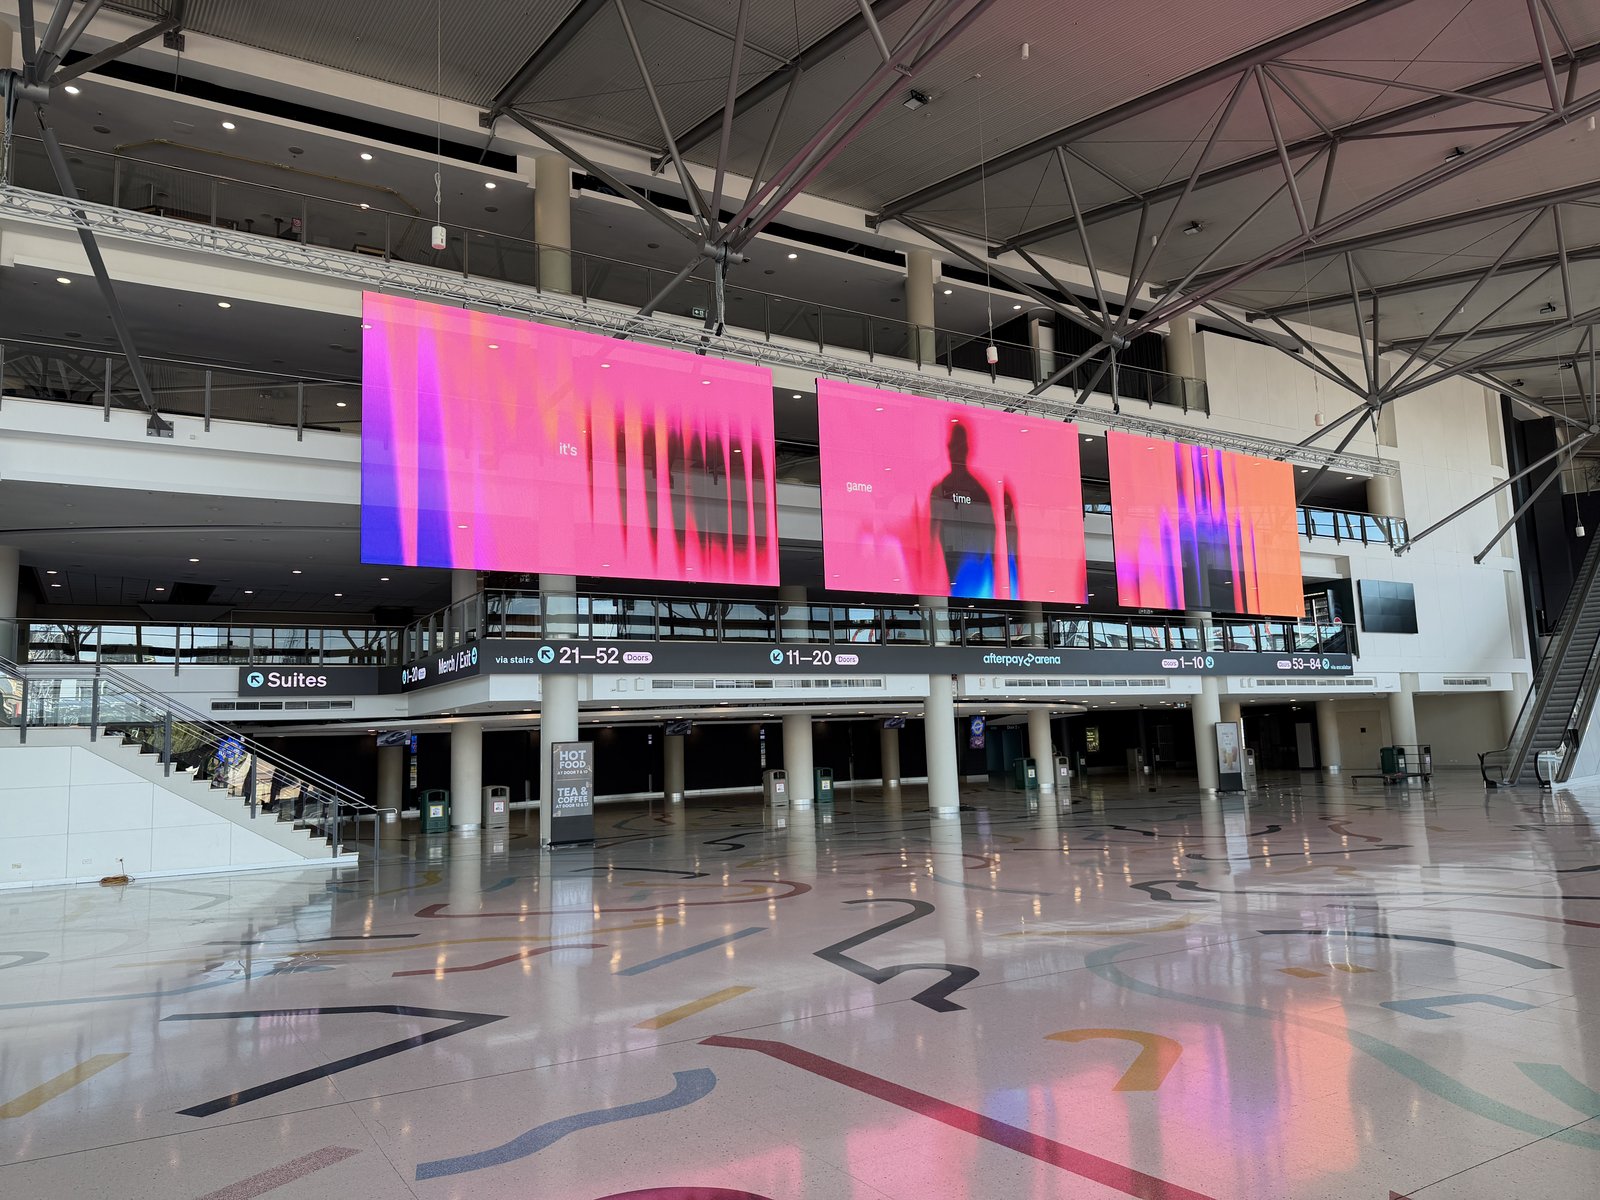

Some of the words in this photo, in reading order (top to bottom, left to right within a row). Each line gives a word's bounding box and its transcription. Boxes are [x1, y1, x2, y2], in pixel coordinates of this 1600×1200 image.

[559, 442, 578, 456] it's
[846, 481, 873, 493] game
[952, 493, 972, 505] time
[438, 654, 456, 675] Merch
[459, 649, 472, 669] Exit
[495, 655, 508, 664] via
[510, 655, 534, 664] stairs
[626, 653, 649, 661] Doors
[983, 652, 1024, 667] afterpay
[1034, 655, 1061, 665] arena
[267, 671, 328, 688] Suites
[559, 750, 586, 761] HOT
[559, 760, 586, 769] FOOD
[557, 787, 578, 797] TEA
[580, 786, 588, 796] &
[557, 795, 588, 804] COFFEE
